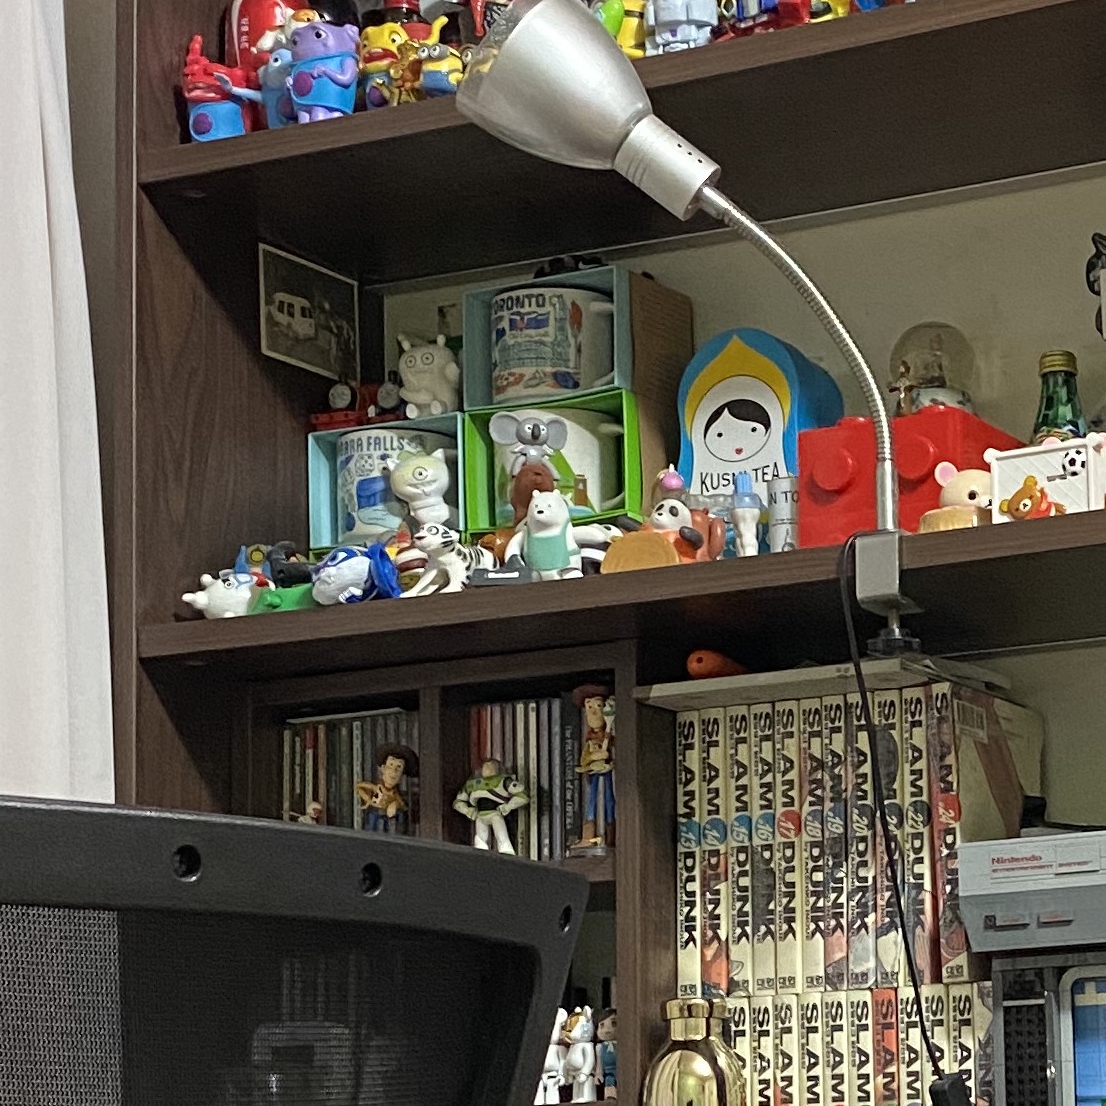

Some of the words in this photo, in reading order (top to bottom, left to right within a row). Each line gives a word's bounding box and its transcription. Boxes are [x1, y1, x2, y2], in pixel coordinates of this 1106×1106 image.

[367, 436, 405, 452] FALLS
[752, 462, 780, 483] TEA
[683, 720, 695, 817] SLAM
[707, 717, 719, 816] SLAM
[735, 714, 748, 812] SLAM
[759, 712, 773, 810] SLAM
[782, 708, 795, 807] SLAM
[808, 707, 823, 806] SLAM
[829, 703, 842, 802] SLAM
[855, 701, 868, 800] SLAM
[909, 697, 923, 798] SLAM
[684, 851, 697, 950] DUNK
[708, 849, 721, 946] DUNK
[736, 845, 750, 945] DUNK
[783, 841, 796, 942] DUNK
[810, 840, 825, 941] DUNK
[855, 835, 869, 935] DUNK
[911, 832, 926, 932] DUNK
[991, 854, 1042, 865] Nintendo
[758, 1006, 770, 1106] SLAM
[780, 1003, 793, 1104] SLAM
[805, 1003, 820, 1104] SLAM
[830, 1001, 845, 1103] SLAM
[856, 1000, 870, 1102] SLAM
[881, 998, 895, 1100] SLAM
[905, 997, 920, 1099] SLAM
